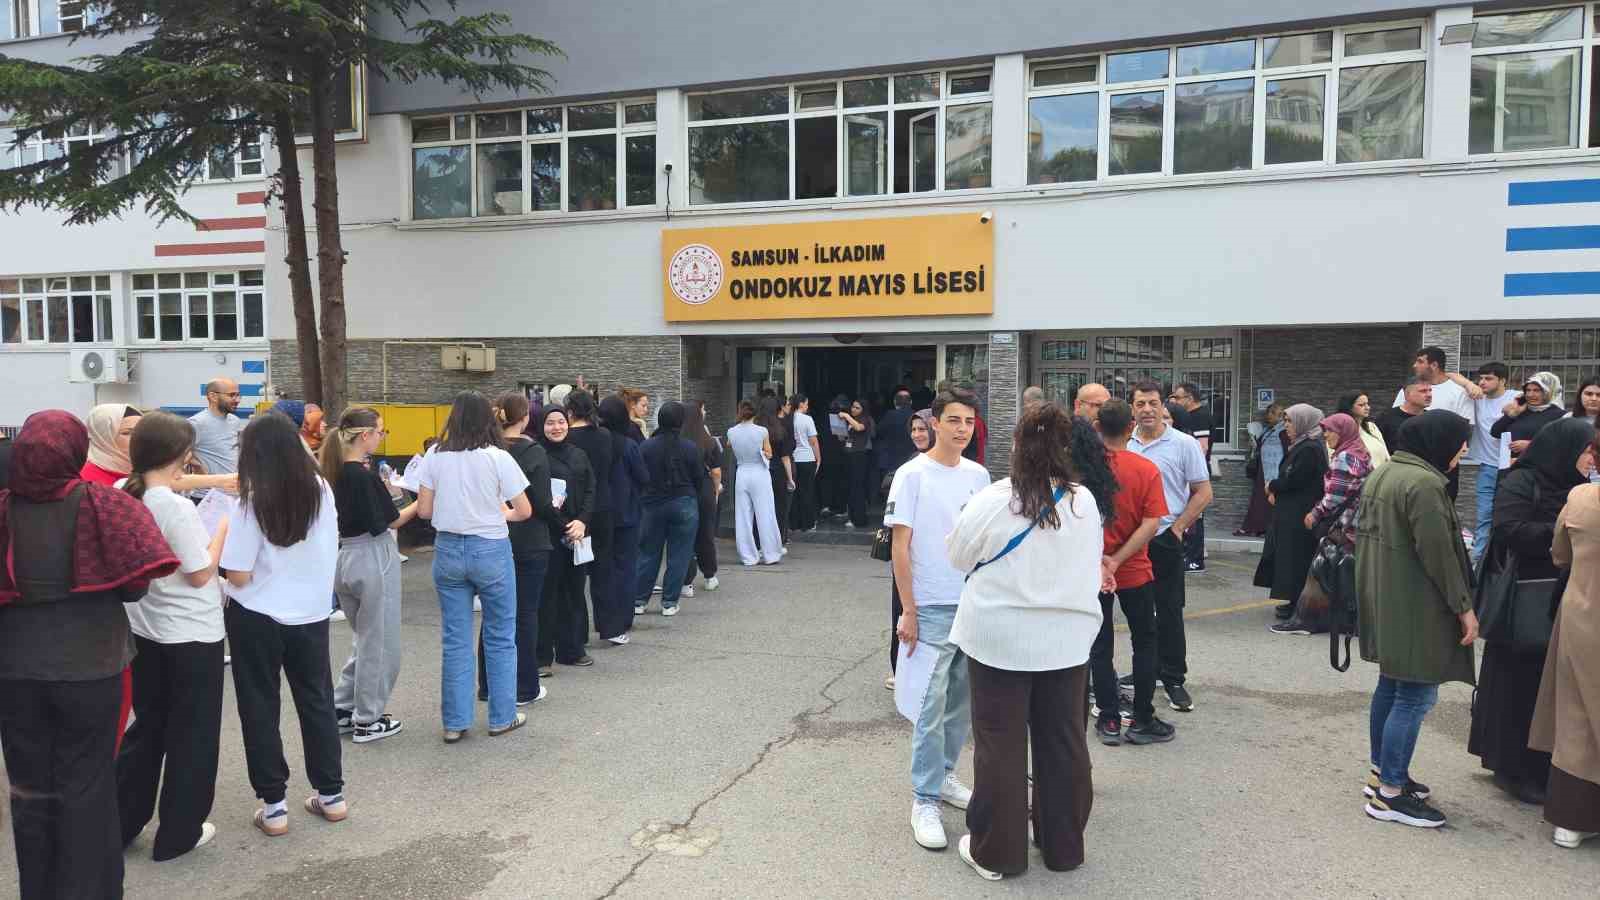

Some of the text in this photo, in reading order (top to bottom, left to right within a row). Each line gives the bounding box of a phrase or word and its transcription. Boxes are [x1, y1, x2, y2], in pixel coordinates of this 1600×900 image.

[731, 248, 799, 267] SAMSUN
[814, 243, 885, 263] İLKADIM
[730, 265, 985, 300] ONDOKUZ MAYIS LİSESİ
